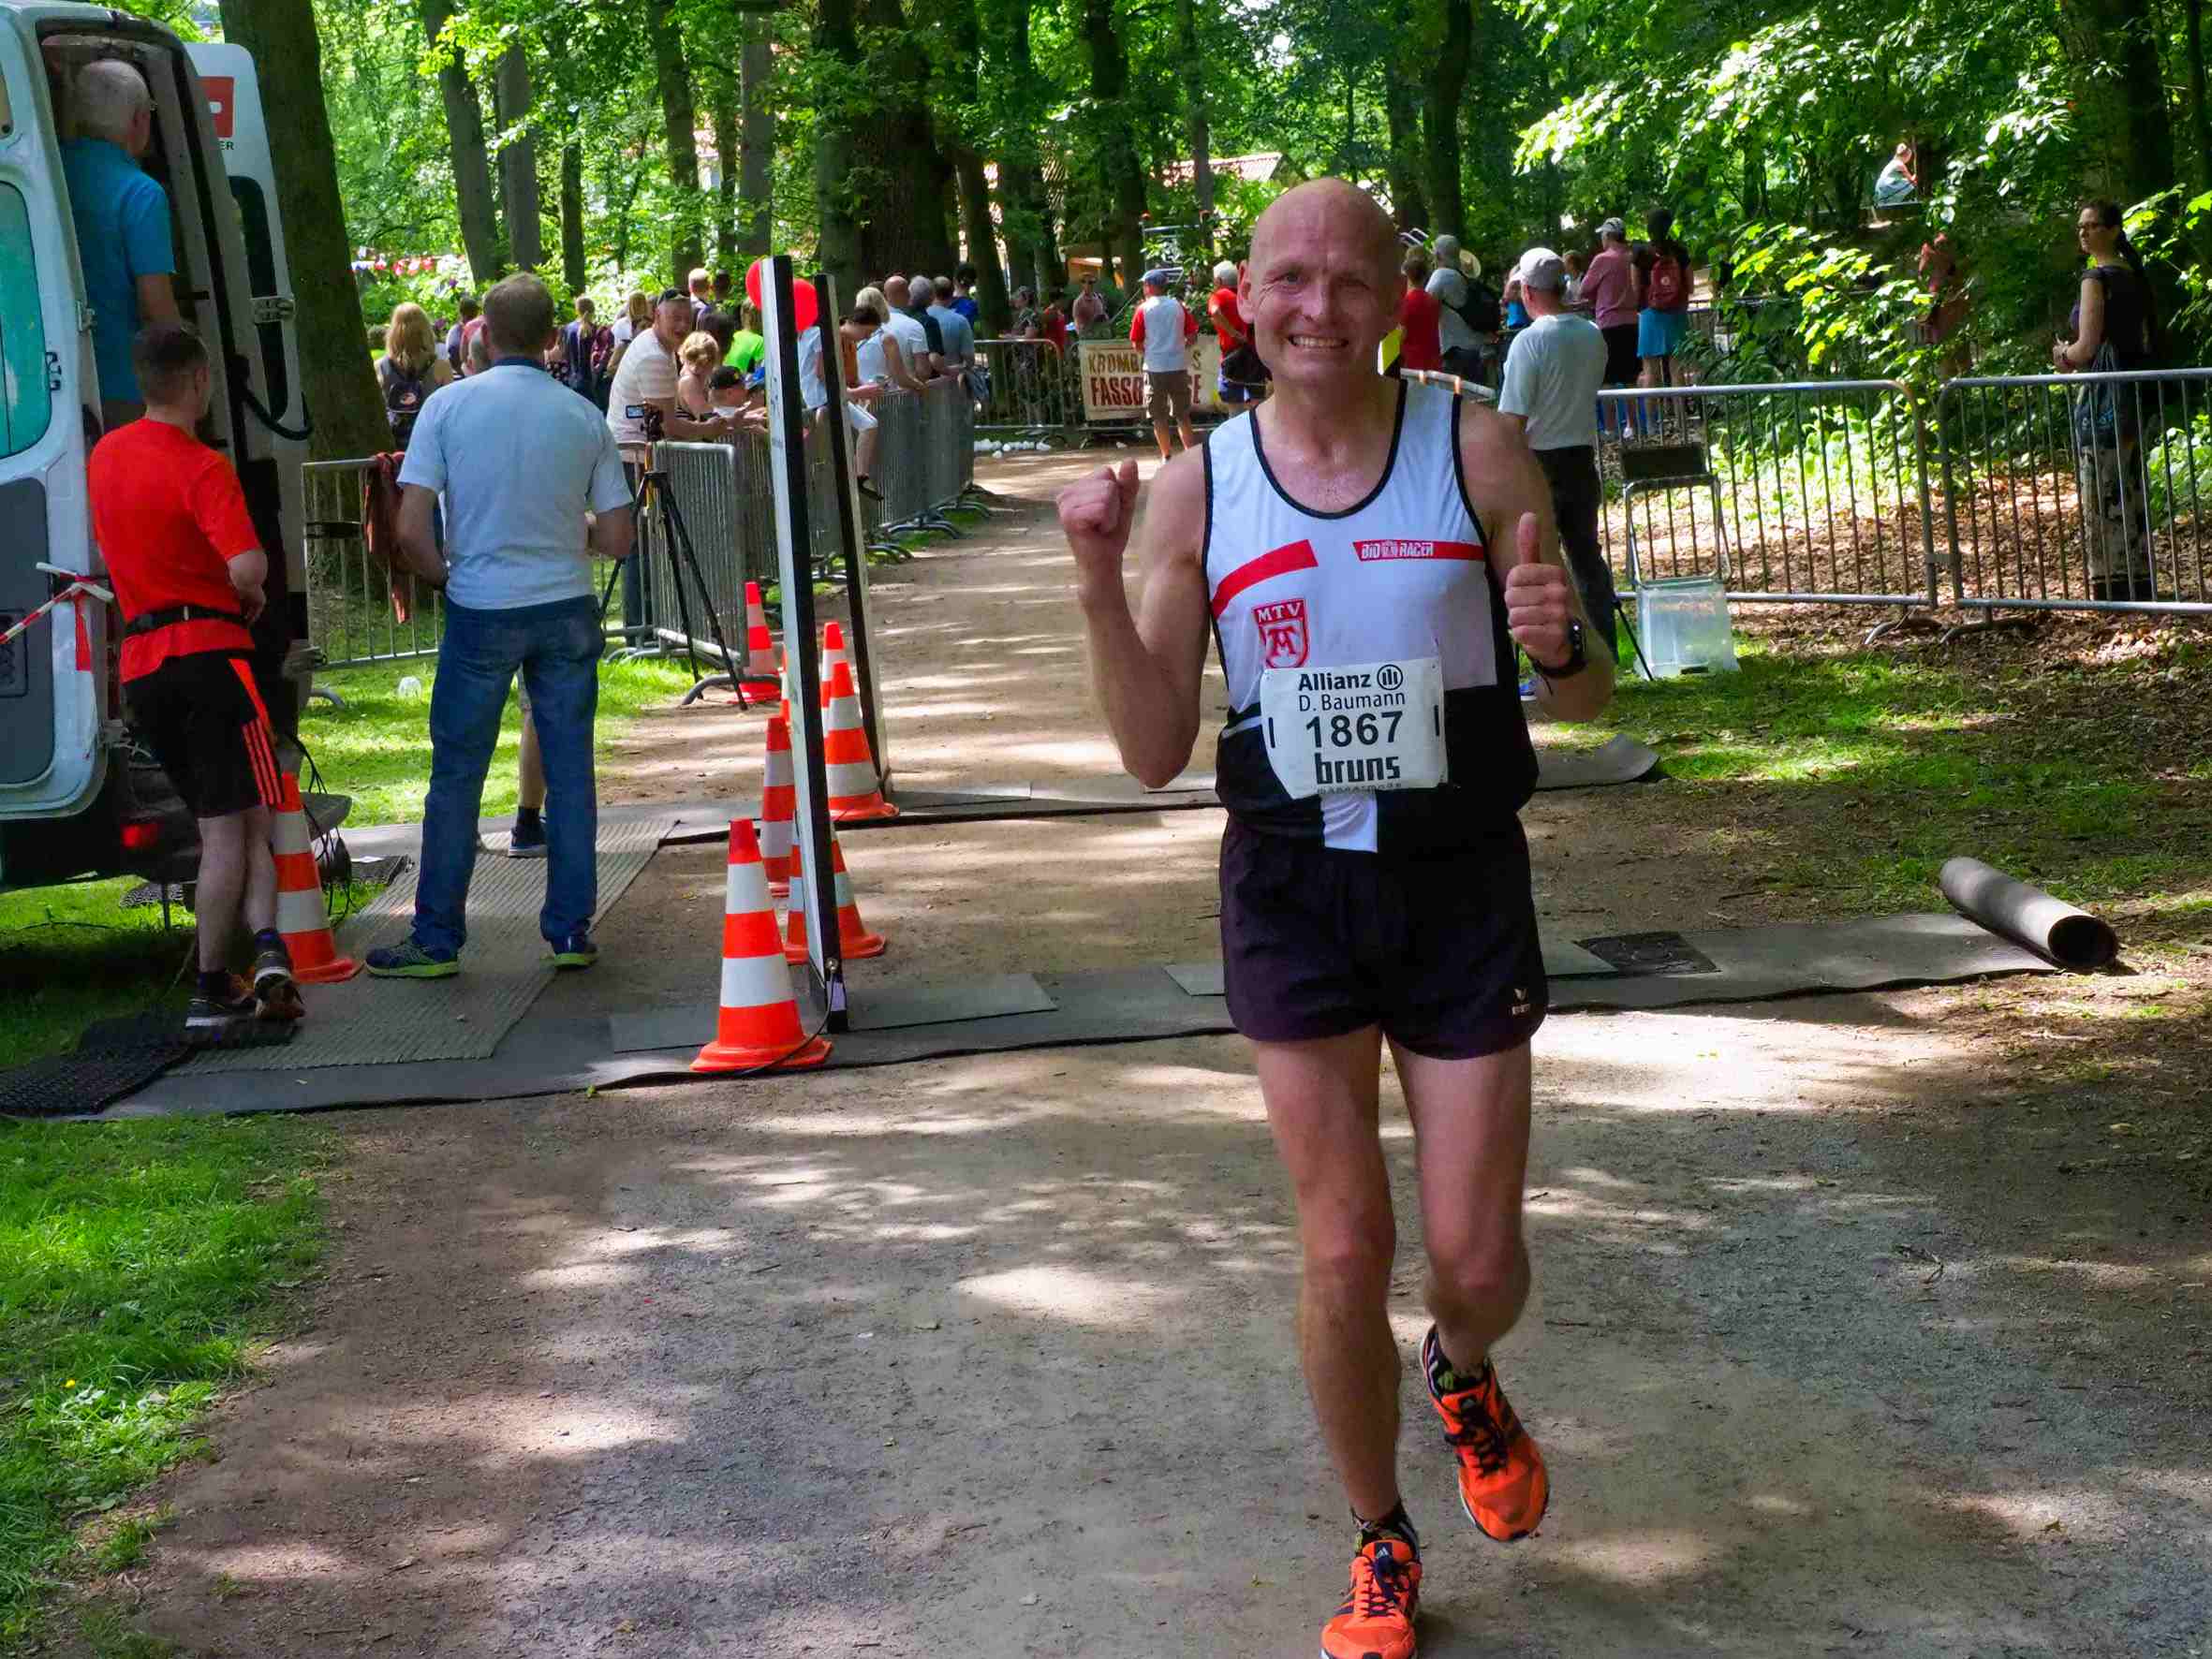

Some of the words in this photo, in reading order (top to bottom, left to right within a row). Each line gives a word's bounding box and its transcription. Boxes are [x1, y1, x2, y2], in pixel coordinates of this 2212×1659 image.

[1256, 602, 1301, 623] MTV
[1298, 672, 1371, 691] Allianz
[1299, 695, 1317, 712] D.
[1321, 692, 1405, 711] Baumann
[1305, 712, 1403, 748] 1867
[1314, 753, 1401, 785] bruns
